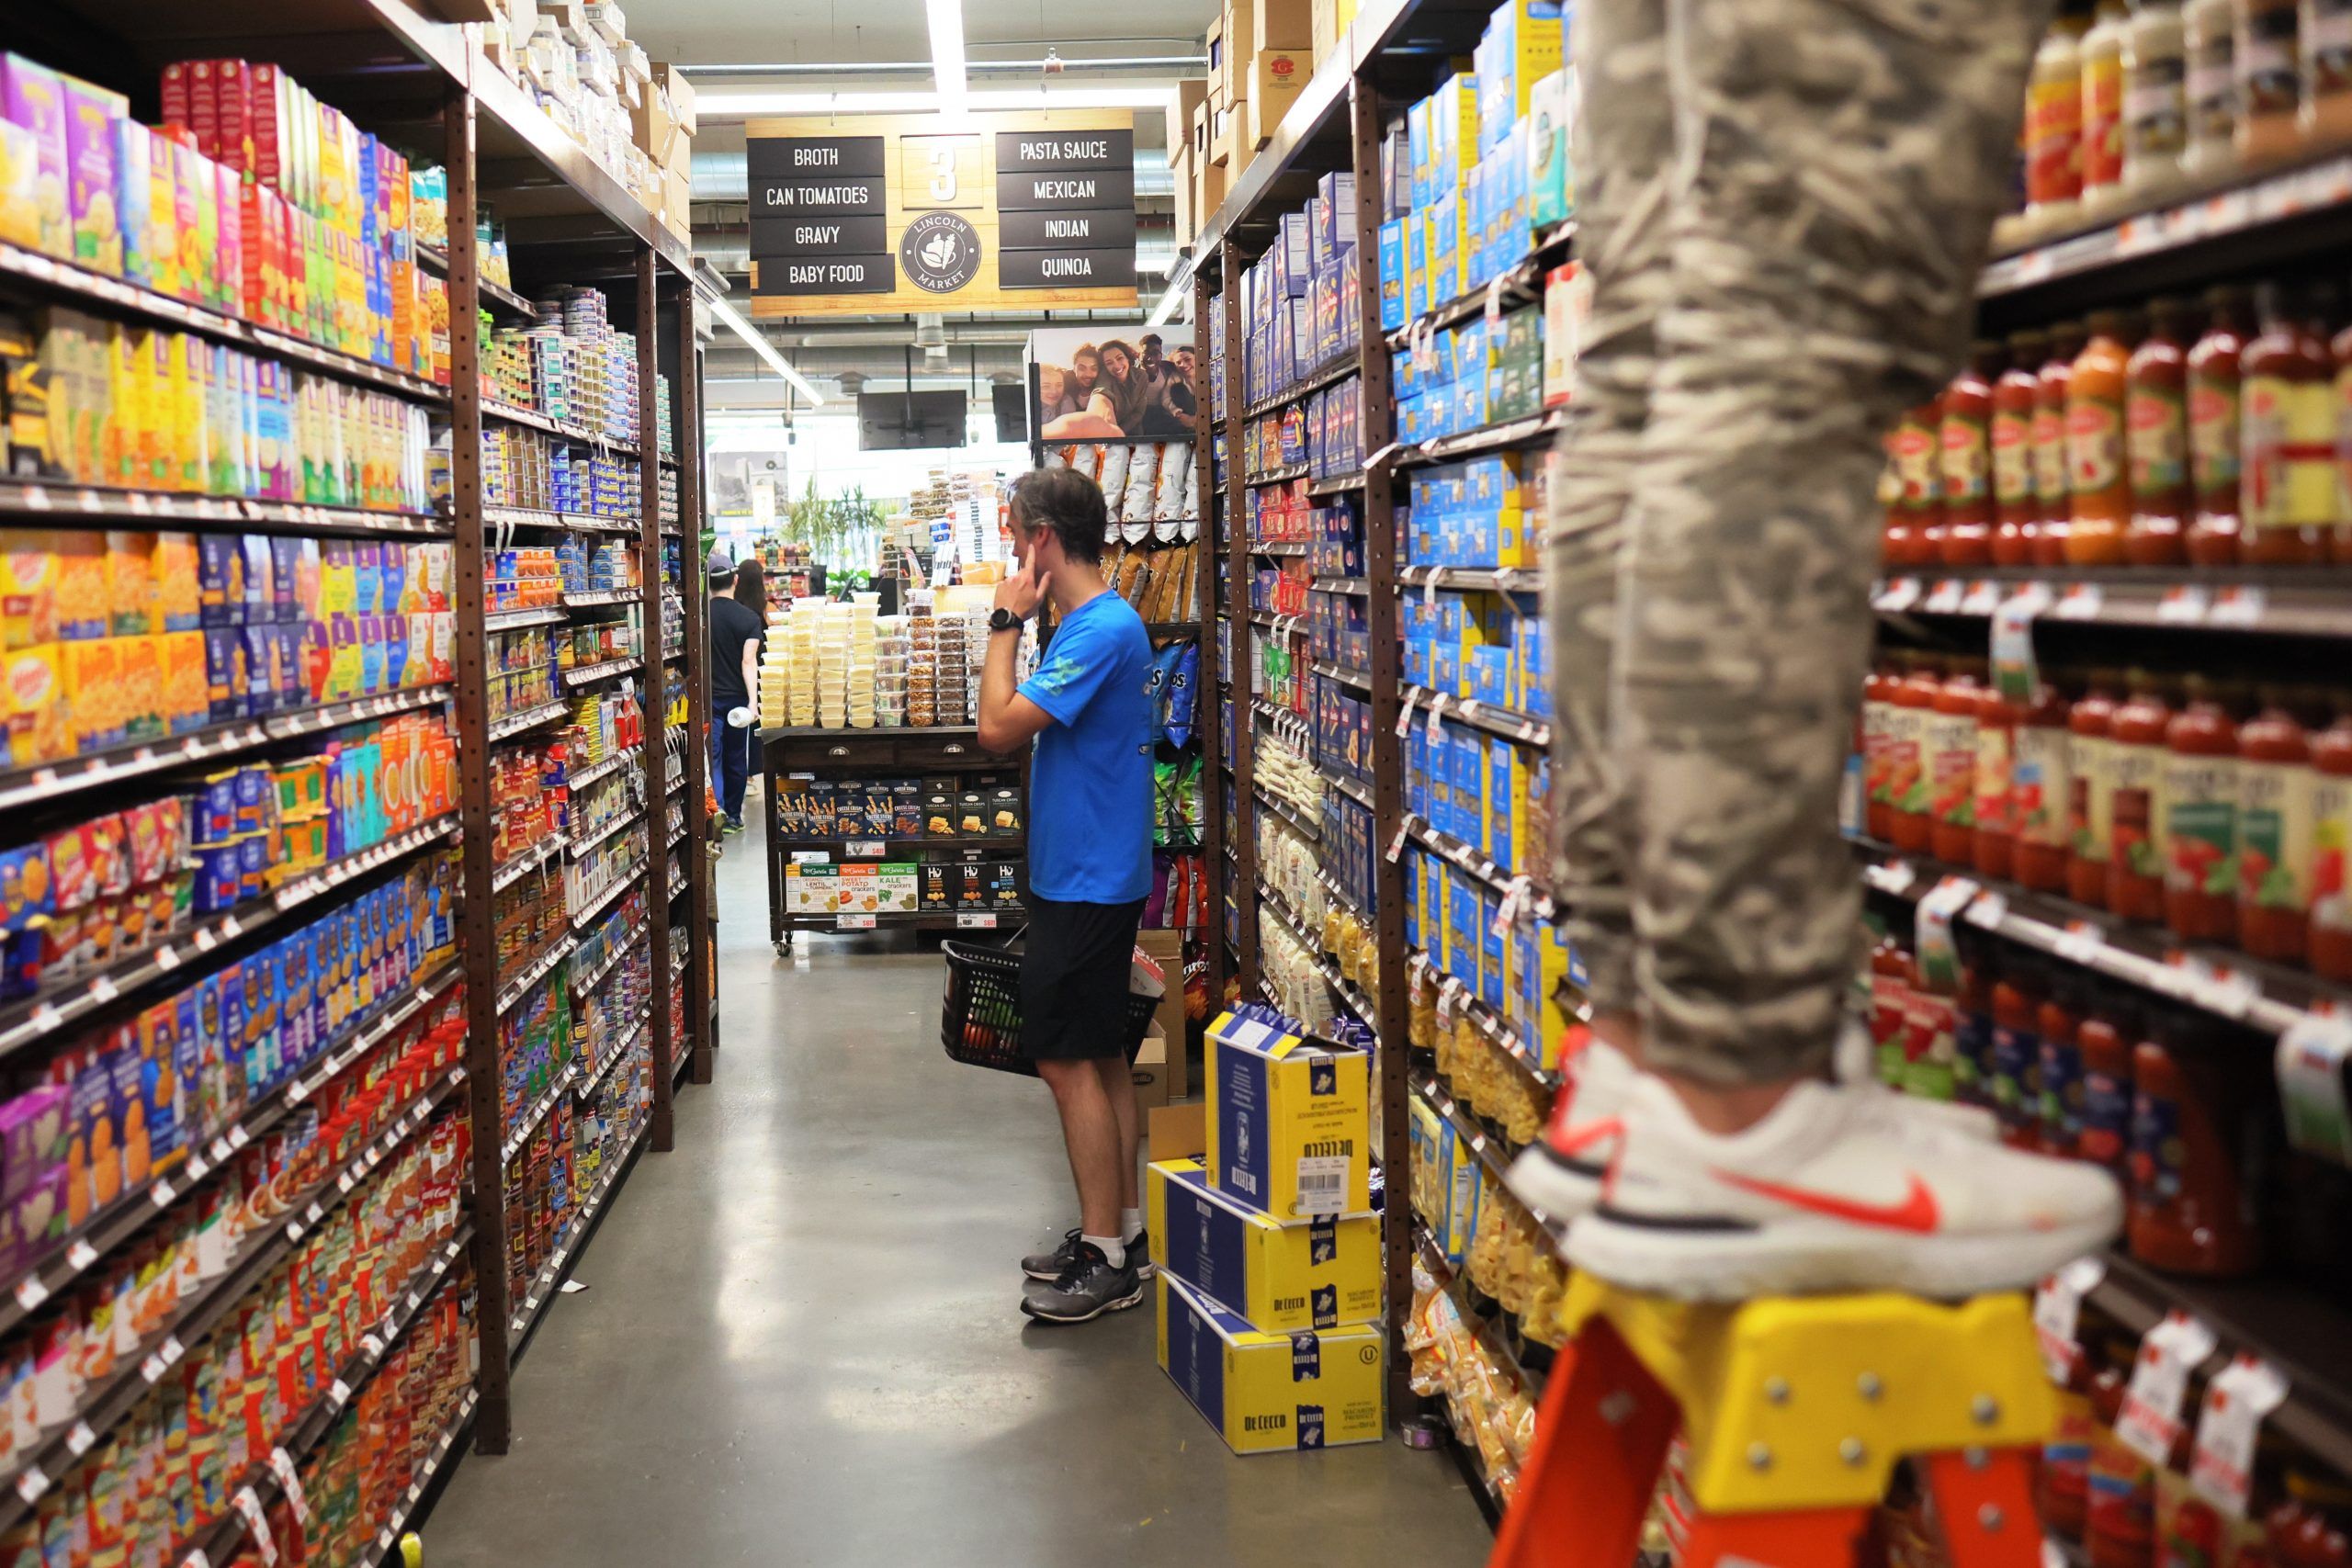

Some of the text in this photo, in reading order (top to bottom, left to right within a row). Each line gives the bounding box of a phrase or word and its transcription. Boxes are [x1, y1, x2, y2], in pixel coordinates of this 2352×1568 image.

[794, 148, 838, 166] BROTH
[1020, 141, 1106, 160] PASTA SAUCE
[930, 144, 956, 201] 3
[766, 186, 867, 206] CAN TOMATOES
[1035, 180, 1095, 199] MEXICAN
[913, 217, 967, 233] LINCOLN
[1046, 220, 1089, 237] INDIAN
[796, 226, 840, 244] GRAVY
[790, 265, 864, 283] BABY FOOD
[1042, 258, 1091, 277] QUINOA
[918, 270, 965, 288] MARKET
